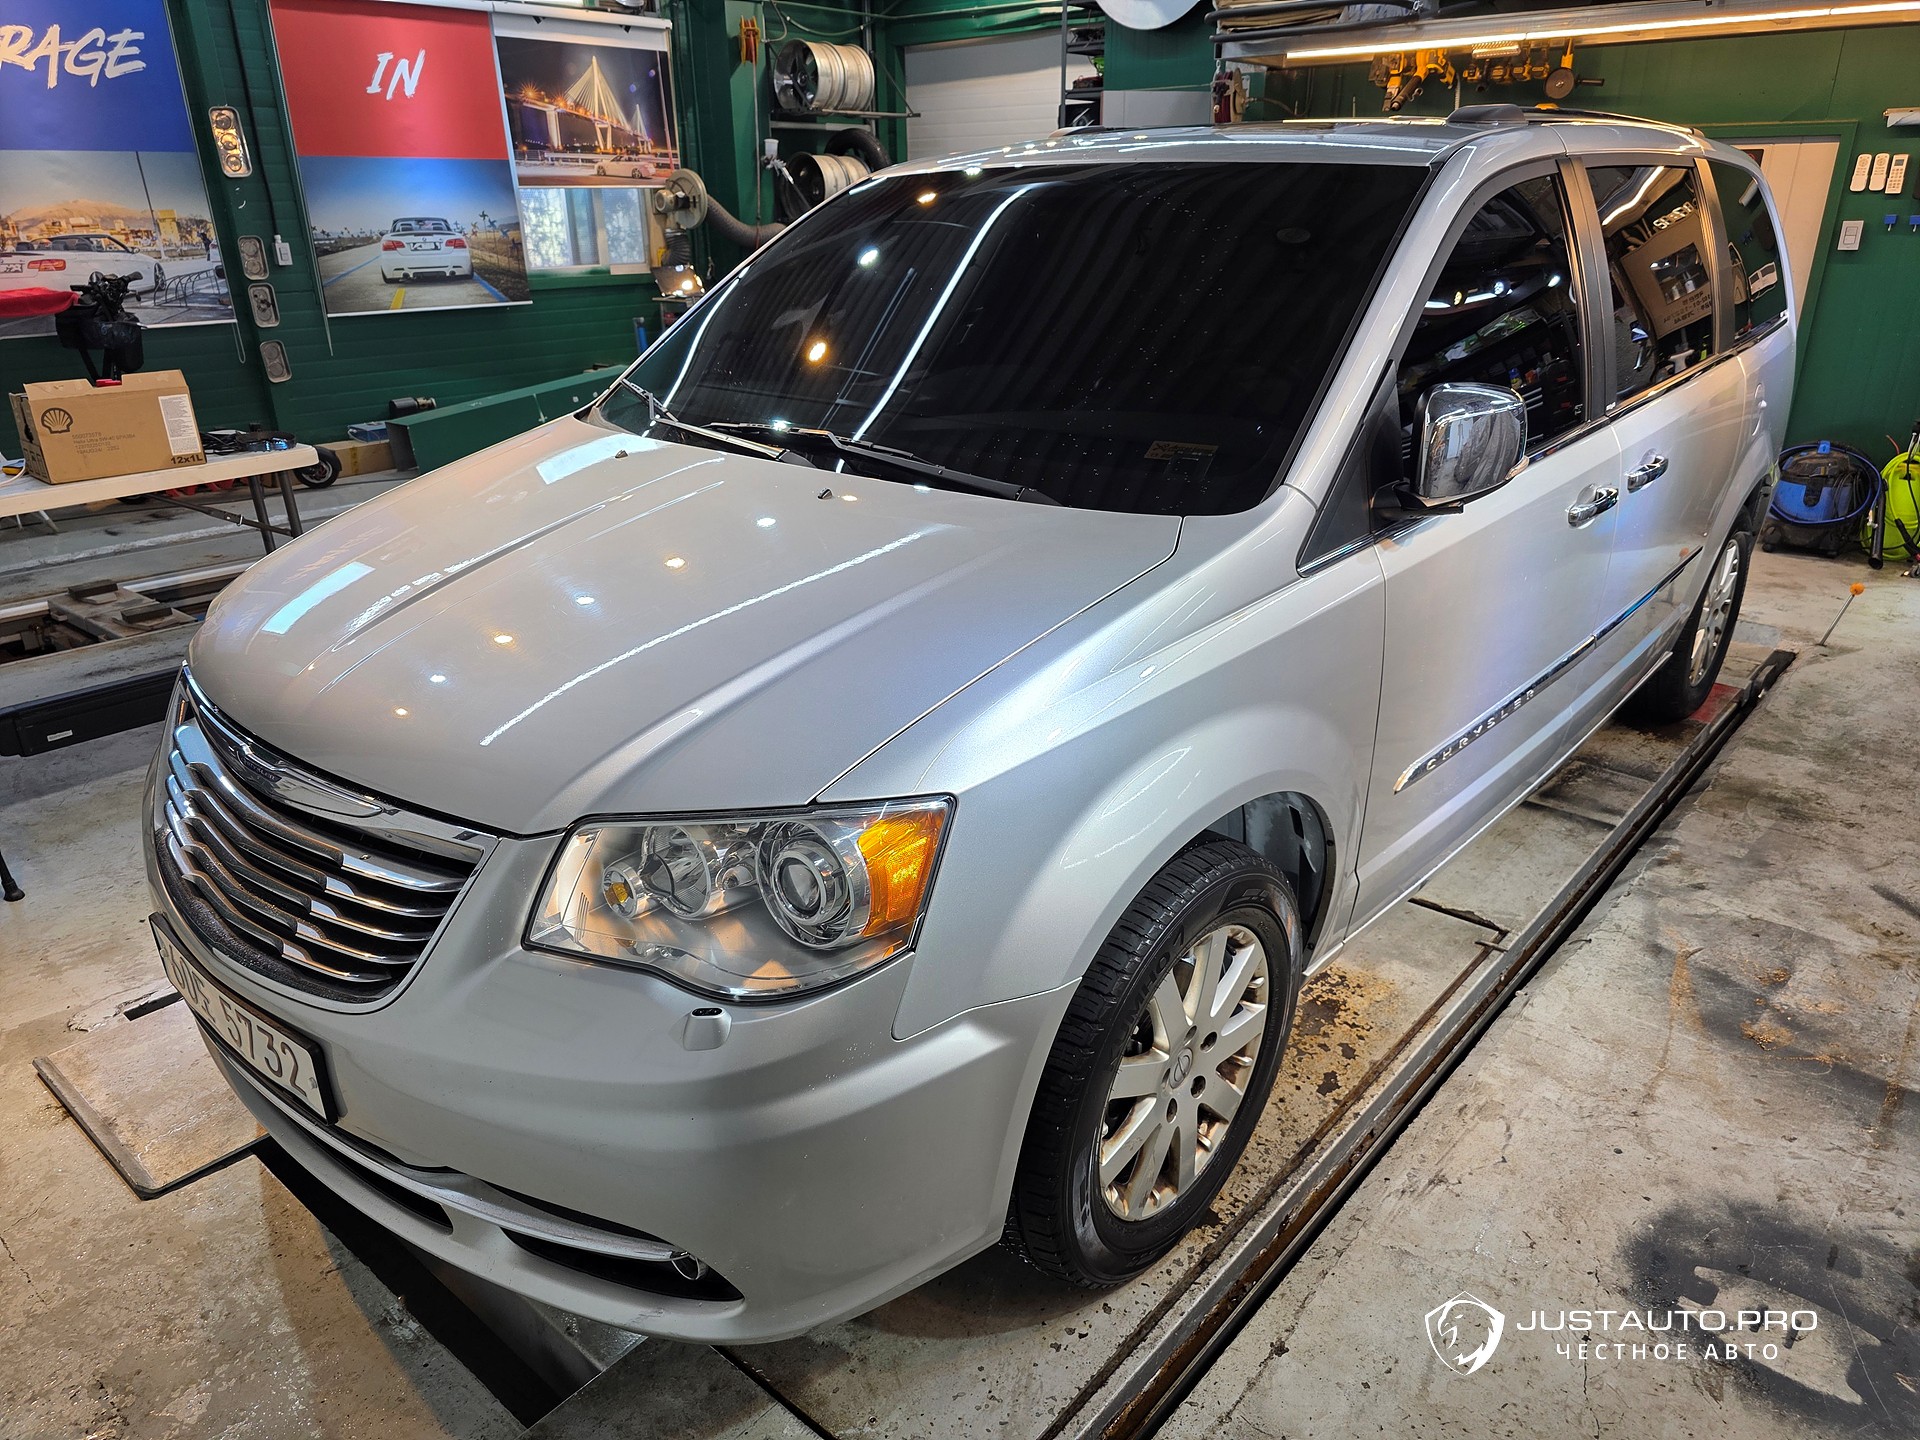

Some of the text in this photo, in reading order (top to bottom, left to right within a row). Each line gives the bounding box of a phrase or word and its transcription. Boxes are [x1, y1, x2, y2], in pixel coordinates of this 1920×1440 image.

[366, 48, 426, 101] IN
[171, 454, 203, 464] 12x1L
[1426, 689, 1534, 771] CHRYSLER
[219, 995, 308, 1098] 5732
